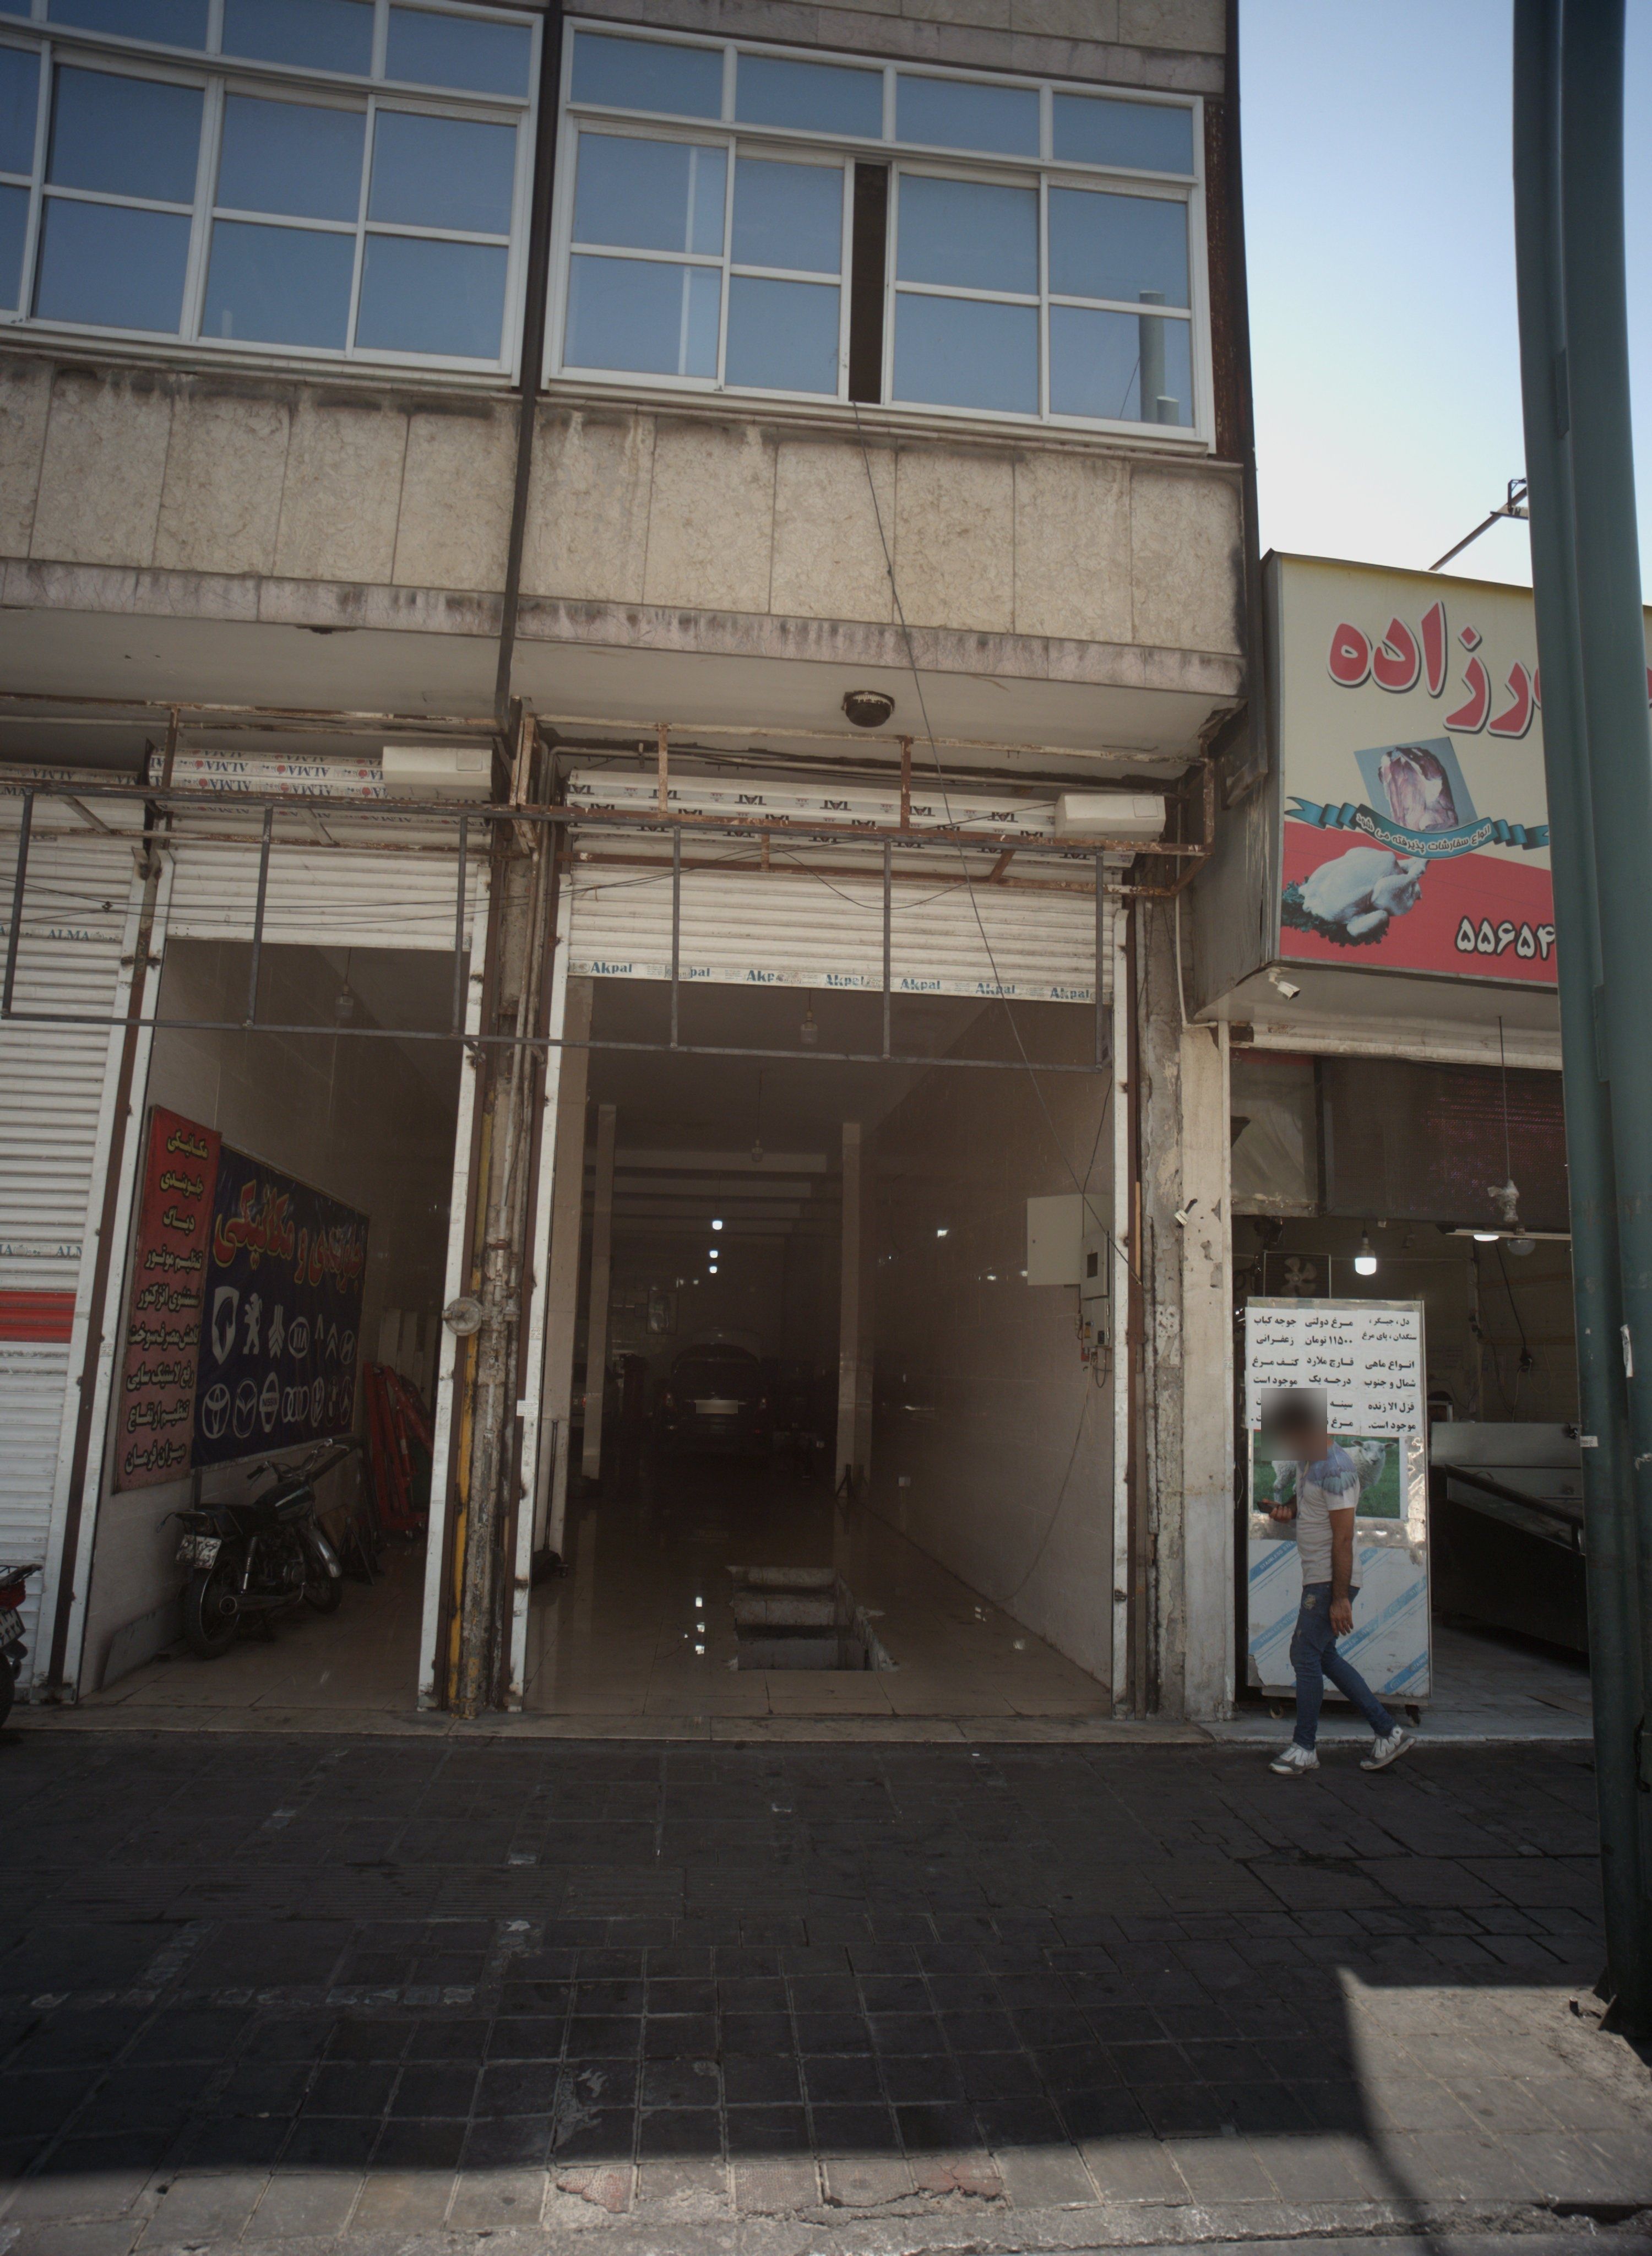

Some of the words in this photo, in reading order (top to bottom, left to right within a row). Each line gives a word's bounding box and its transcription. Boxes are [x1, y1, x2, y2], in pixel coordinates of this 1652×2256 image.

[1328, 601, 1541, 734] رزاده
[206, 760, 248, 772] ALMA
[288, 766, 330, 777] ALMA
[209, 779, 252, 791] ALMA
[735, 794, 767, 805] TAT
[820, 800, 851, 811] TAT
[987, 811, 1018, 822] TAT
[1356, 814, 1374, 831] شود
[1376, 829, 1390, 840] می
[1471, 824, 1491, 844] انواع
[1393, 836, 1425, 854] پذیرفته
[1428, 839, 1469, 851] سفارشات
[48, 929, 89, 941] ALMA
[590, 962, 632, 974] Akpal
[691, 967, 710, 979] pal
[747, 970, 774, 983] Akp
[900, 978, 941, 990] Akpal
[975, 983, 1015, 995] Akpal
[1050, 988, 1089, 1000] Akpal
[167, 1129, 209, 1160] مکانیکی
[160, 1169, 204, 1200] جلوبندی
[162, 1206, 195, 1235] دیاگ
[213, 1179, 296, 1271] مکانیکی
[56, 1245, 82, 1257] ALM
[294, 1227, 307, 1284] و
[144, 1244, 175, 1271] موتور
[175, 1247, 203, 1274] تنظیم
[1254, 1316, 1273, 1326] کباب
[1274, 1317, 1297, 1327] جوجه
[1305, 1317, 1329, 1328] دولتی
[1331, 1317, 1354, 1328] مرغ
[1400, 1318, 1410, 1326] دل
[1256, 1334, 1294, 1346] زعفرانی
[1305, 1335, 1327, 1346] تومان
[1329, 1336, 1352, 1345] ۱۱۵۰۰
[1362, 1331, 1374, 1340] مرغ
[1376, 1332, 1387, 1342] پای
[1393, 1333, 1417, 1341] سنگدان
[1252, 1356, 1274, 1368] مرغ
[1276, 1358, 1299, 1366] کتف
[1307, 1356, 1327, 1367] ملارد
[1329, 1357, 1354, 1368] قارچ
[1365, 1359, 1385, 1370] ماهی
[1388, 1360, 1415, 1370] انواع
[1272, 1377, 1298, 1387] موجود
[1308, 1375, 1321, 1385] یک
[1324, 1378, 1351, 1387] درجه
[1364, 1381, 1386, 1389] جنوب
[1396, 1379, 1416, 1389] شمال
[1330, 1400, 1354, 1410] سینه
[1368, 1402, 1386, 1413] زنده
[1389, 1402, 1397, 1410] الا
[1399, 1402, 1415, 1413] قزل
[127, 1401, 161, 1433] ارتفاع
[161, 1399, 189, 1429] تنظیم
[1331, 1417, 1354, 1429] مرغ
[1391, 1422, 1416, 1432] موجود
[124, 1439, 158, 1474] فرمان
[157, 1439, 186, 1468] میزان
